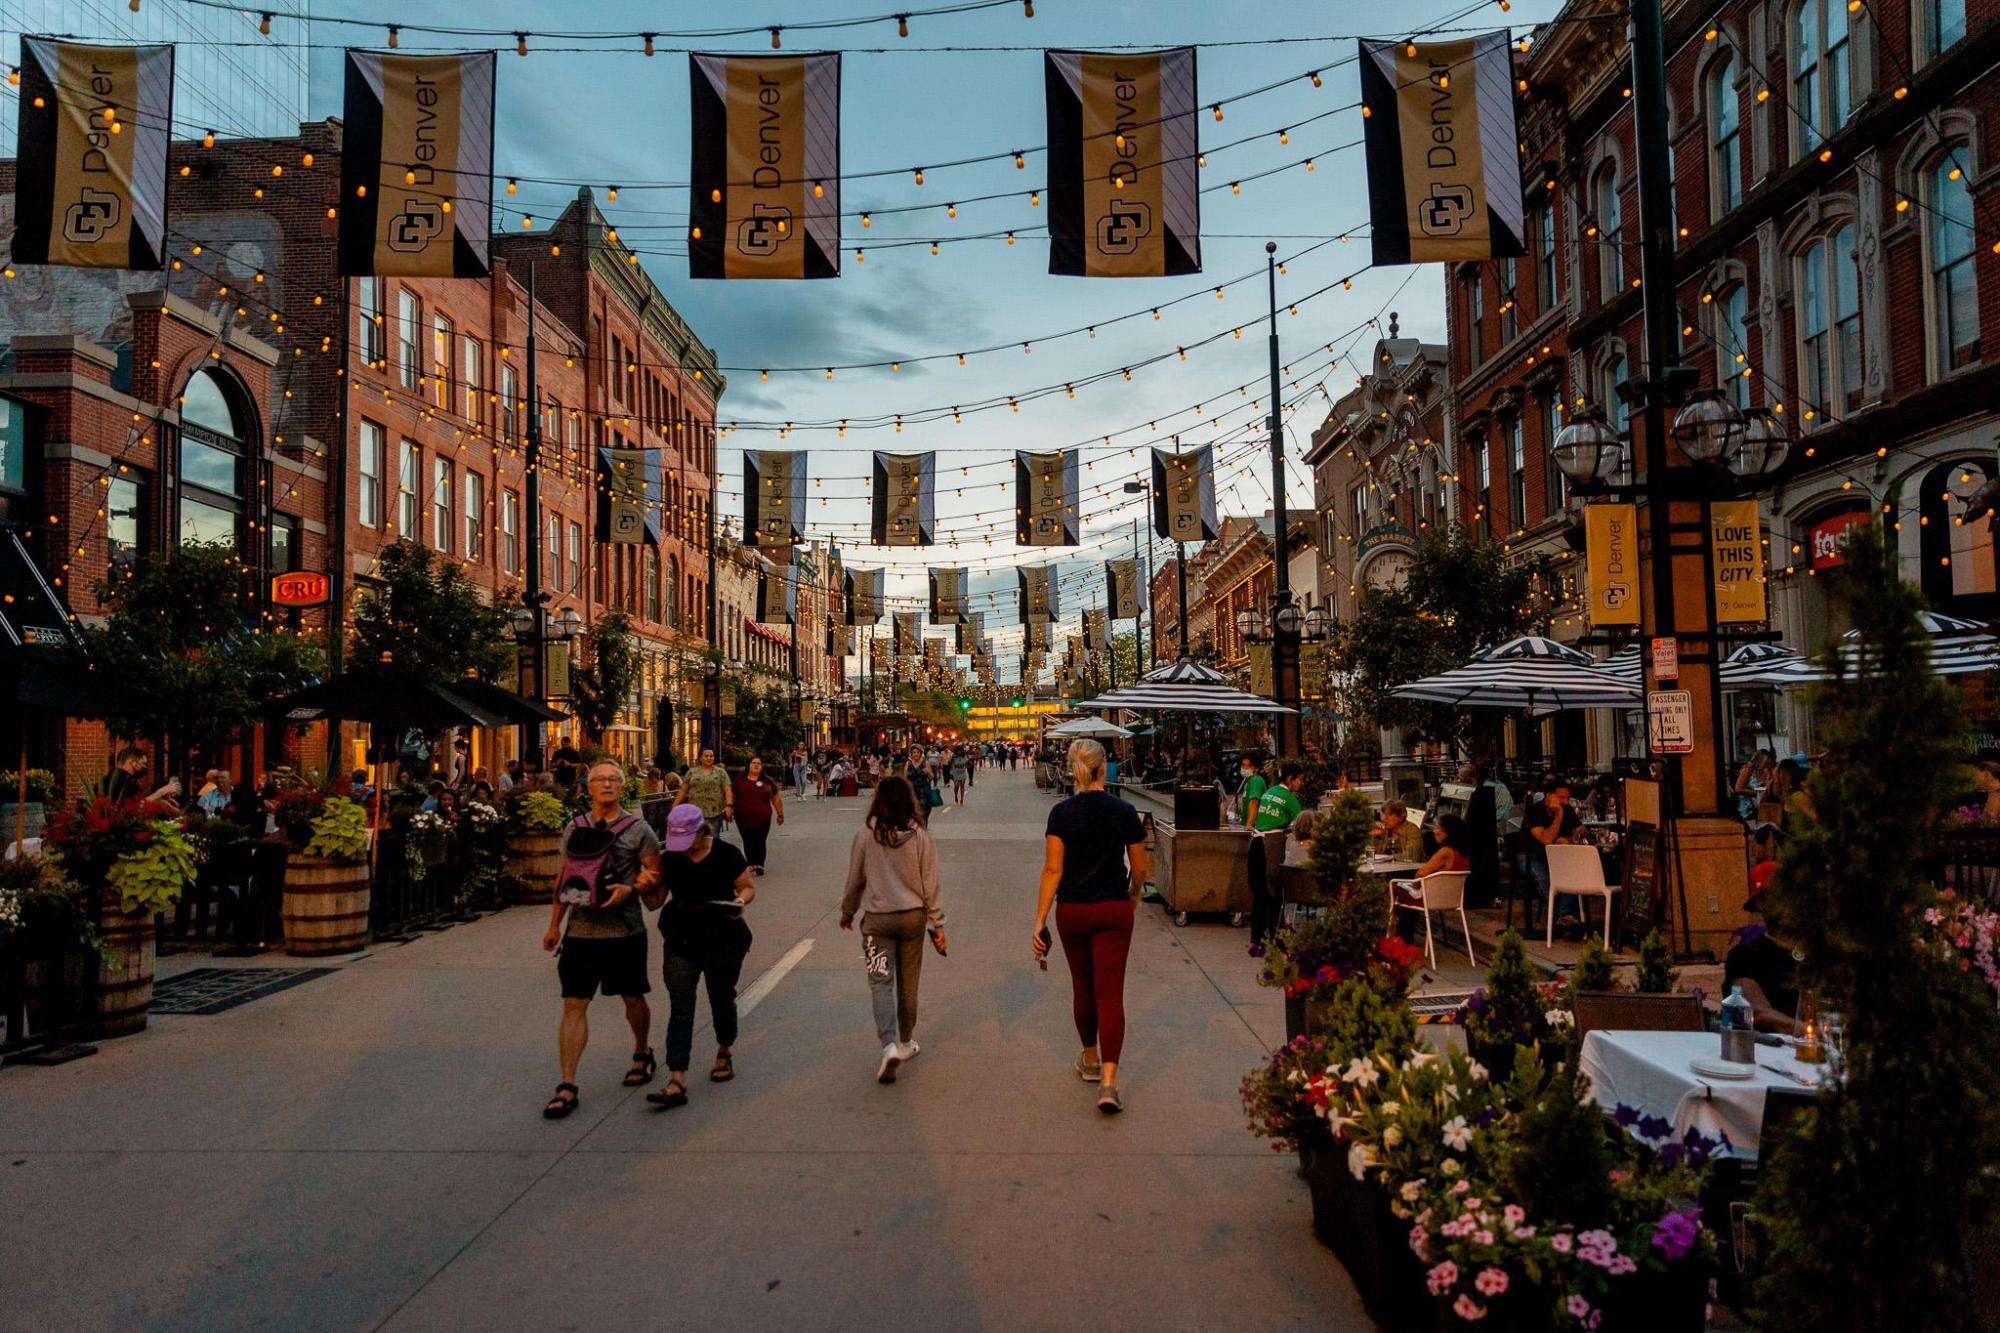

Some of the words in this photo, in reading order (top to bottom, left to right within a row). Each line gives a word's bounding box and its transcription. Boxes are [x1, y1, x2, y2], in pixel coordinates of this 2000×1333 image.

[82, 64, 114, 173] Denver
[412, 74, 439, 186] Denver
[1109, 71, 1137, 185] Denver
[1428, 57, 1458, 169] Denver
[753, 75, 781, 189] Denver
[769, 460, 784, 507] Denver
[898, 461, 913, 508] Denver
[1041, 460, 1055, 507] Denver
[1608, 518, 1623, 575] Denver
[1715, 526, 1752, 542] LOVE
[1717, 547, 1754, 563] THIS
[278, 576, 322, 597] CRÚ
[1719, 566, 1754, 583] CITY
[1732, 600, 1758, 610] Denver
[1655, 649, 1674, 657] Valet
[1651, 694, 1687, 704] PASSENGER
[1674, 705, 1688, 714] ONLY
[1664, 715, 1676, 724] ALL
